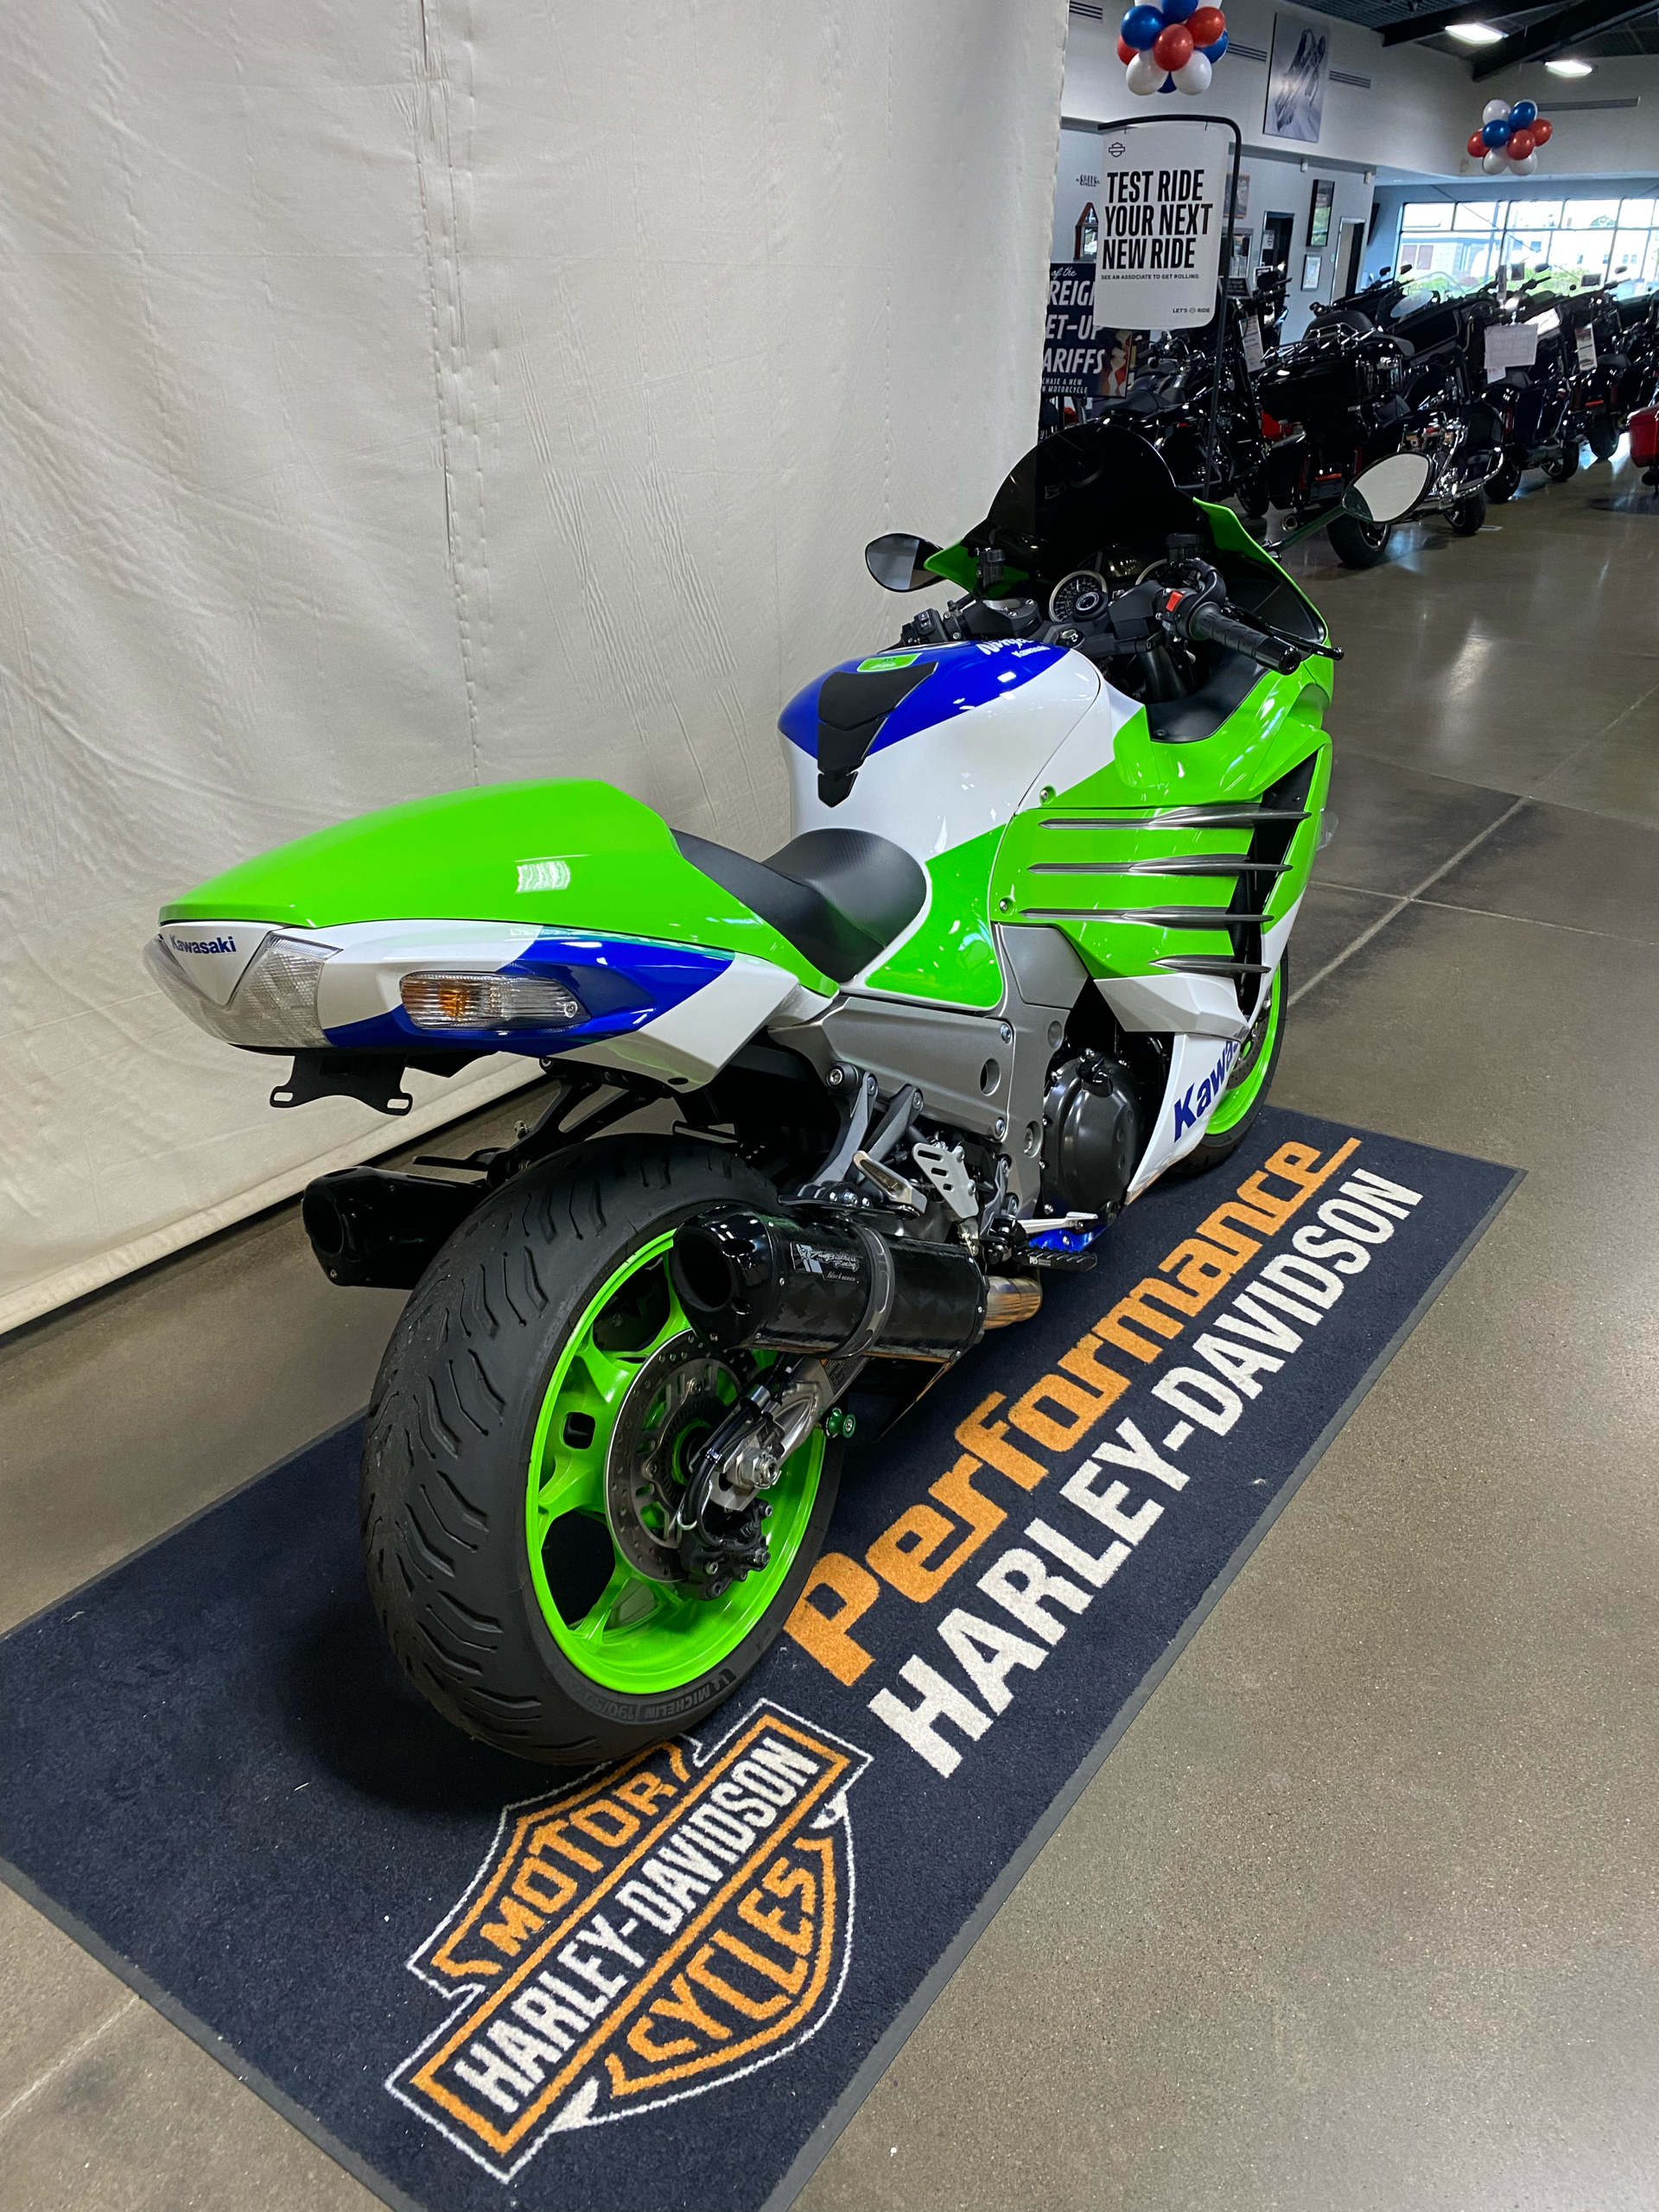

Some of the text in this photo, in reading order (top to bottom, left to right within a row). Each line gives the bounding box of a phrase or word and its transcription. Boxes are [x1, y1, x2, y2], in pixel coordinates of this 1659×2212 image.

[1107, 168, 1205, 204] TEST RIDE
[1104, 203, 1213, 237] YOUR NEXT
[1102, 237, 1197, 270] NEW RIDE
[1051, 265, 1077, 280] of the
[1043, 347, 1106, 374] ARIFFS
[1048, 385, 1089, 394] MOTORCYCLE
[168, 933, 237, 955] Kawasaki
[784, 1137, 1362, 1688] Performance
[867, 1168, 1424, 1779] HARLEY-DAVIDSON
[645, 1687, 712, 1714] MICHELIN
[480, 1771, 677, 1956] MOTOR
[453, 1737, 821, 2114] HARLEY-DAVIDSON
[626, 1857, 817, 2063] CYCLES
